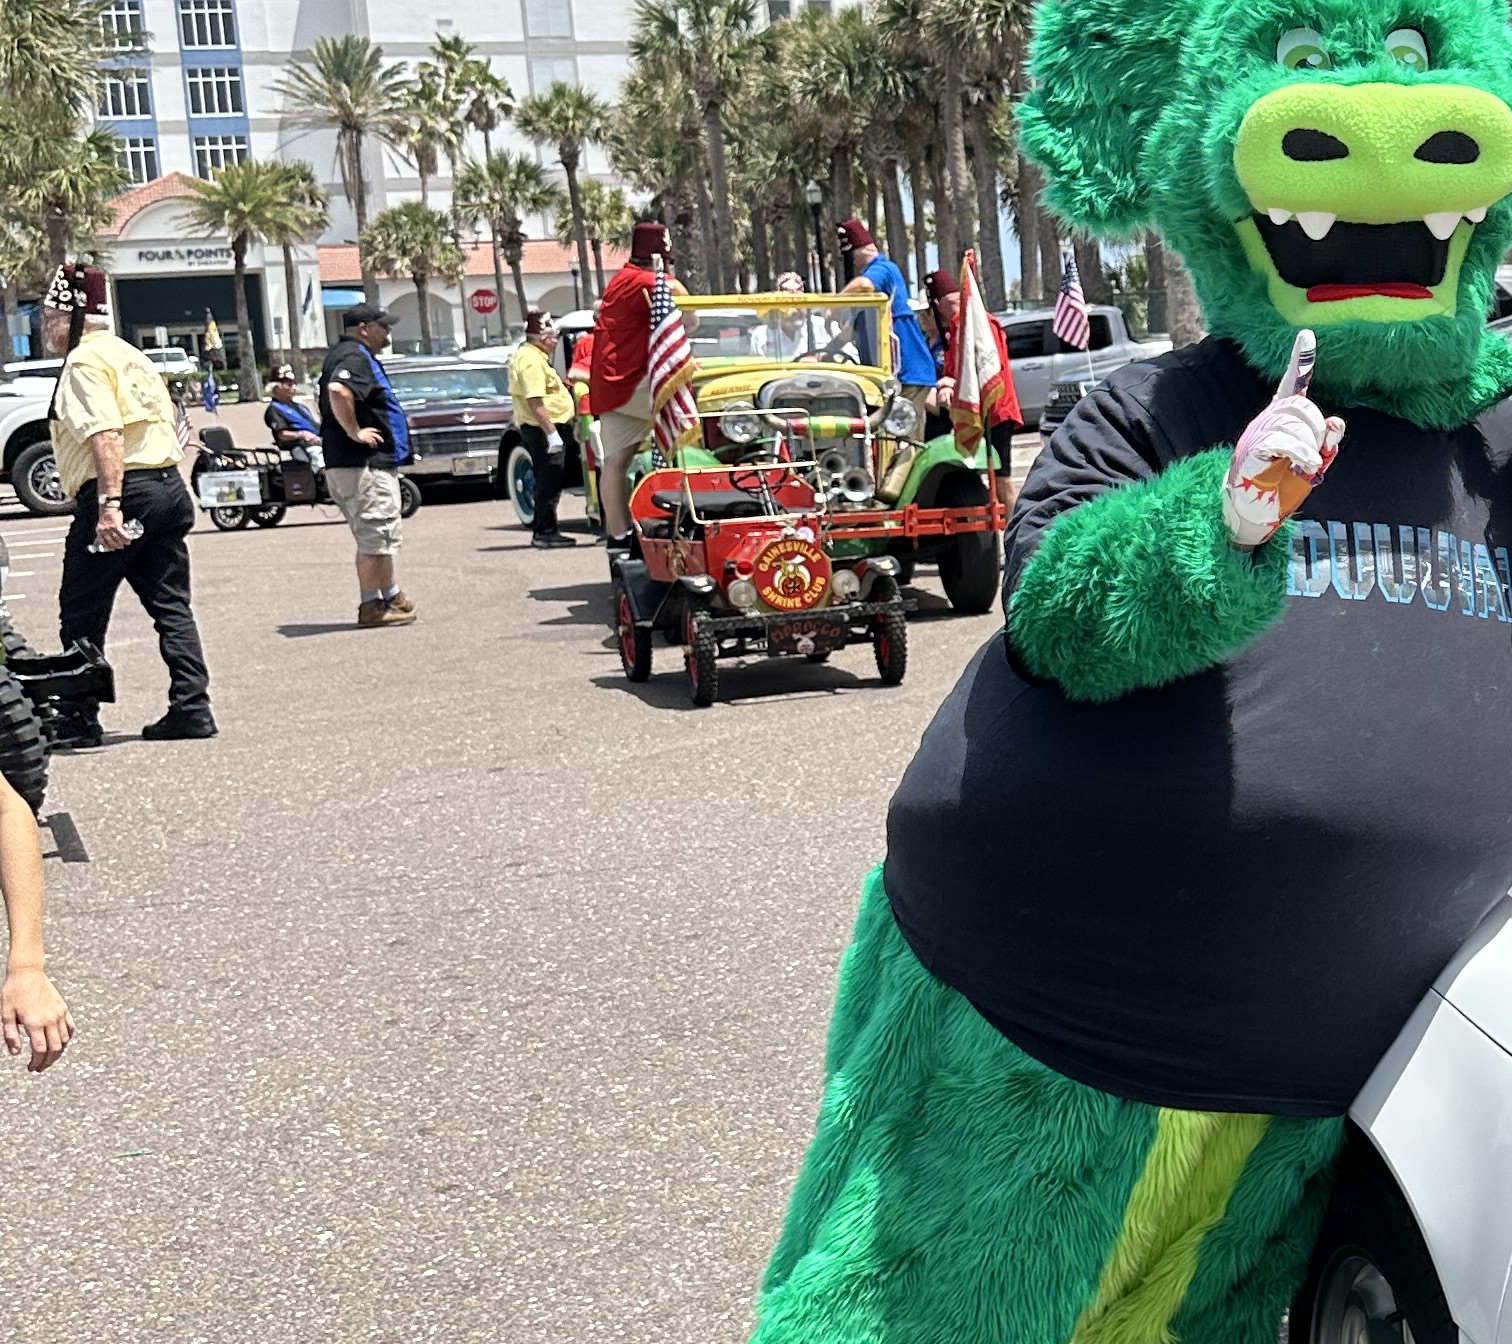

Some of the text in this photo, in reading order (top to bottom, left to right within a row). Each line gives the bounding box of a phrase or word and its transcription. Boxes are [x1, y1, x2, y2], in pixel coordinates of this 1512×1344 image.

[139, 248, 233, 261] FOUR POINTS
[472, 295, 497, 307] STOP
[758, 541, 823, 572] GAINESVILLE
[762, 576, 827, 608] SHRINE CLUB
